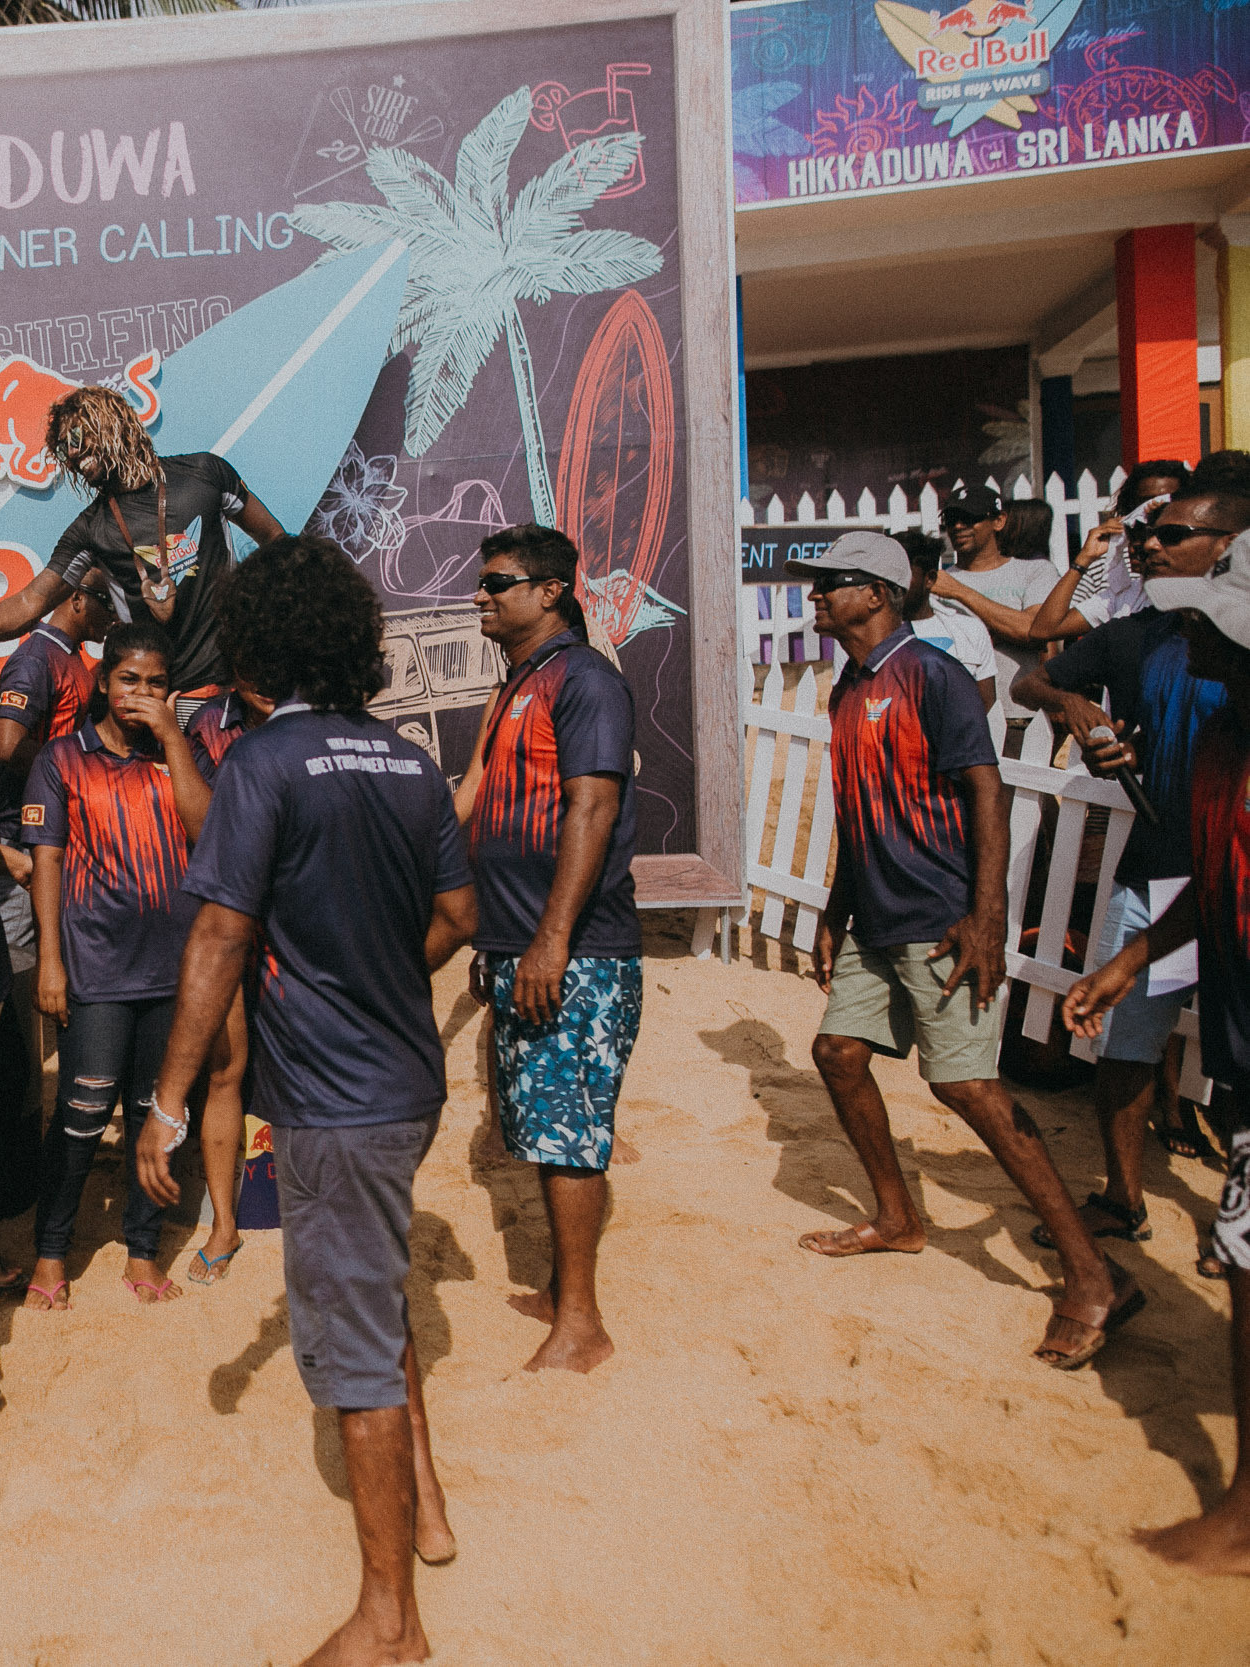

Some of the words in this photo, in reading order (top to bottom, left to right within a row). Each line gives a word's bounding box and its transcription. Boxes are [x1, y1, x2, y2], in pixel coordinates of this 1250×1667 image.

[918, 41, 979, 76] Red
[986, 31, 1047, 66] Bull
[361, 84, 419, 124] SURF
[925, 84, 962, 101] RIDE
[964, 81, 993, 99] my
[992, 73, 1041, 93] WAVE
[364, 115, 400, 142] CLUB
[787, 138, 974, 198] HIKKADUWA
[1016, 126, 1068, 169] SRI
[1084, 110, 1198, 161] LANKA
[99, 211, 294, 264] CALLING
[155, 551, 177, 569] Rd
[176, 540, 199, 559] Bull
[741, 542, 778, 569] ENT
